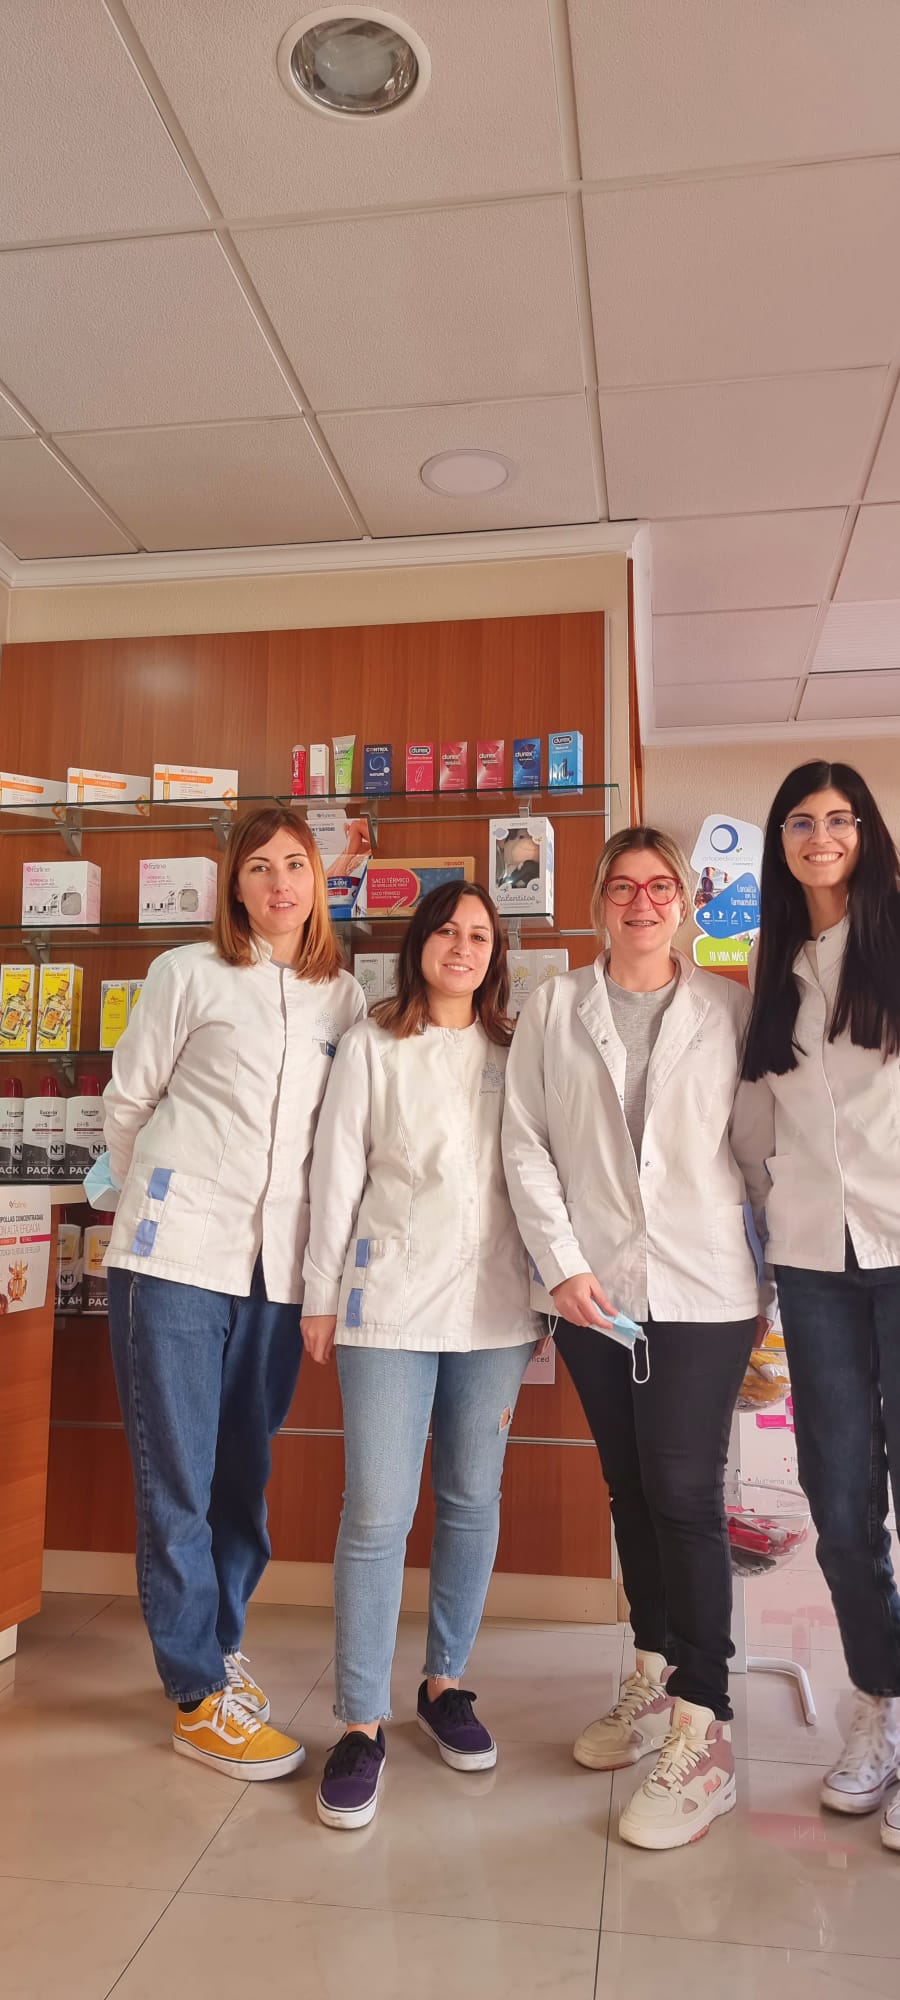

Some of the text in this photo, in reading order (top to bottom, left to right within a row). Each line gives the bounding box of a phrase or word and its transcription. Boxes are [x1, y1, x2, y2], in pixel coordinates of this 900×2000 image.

[26, 1166, 55, 1175] PACK
[69, 1166, 91, 1175] PAC
[88, 1298, 109, 1307] PAC
